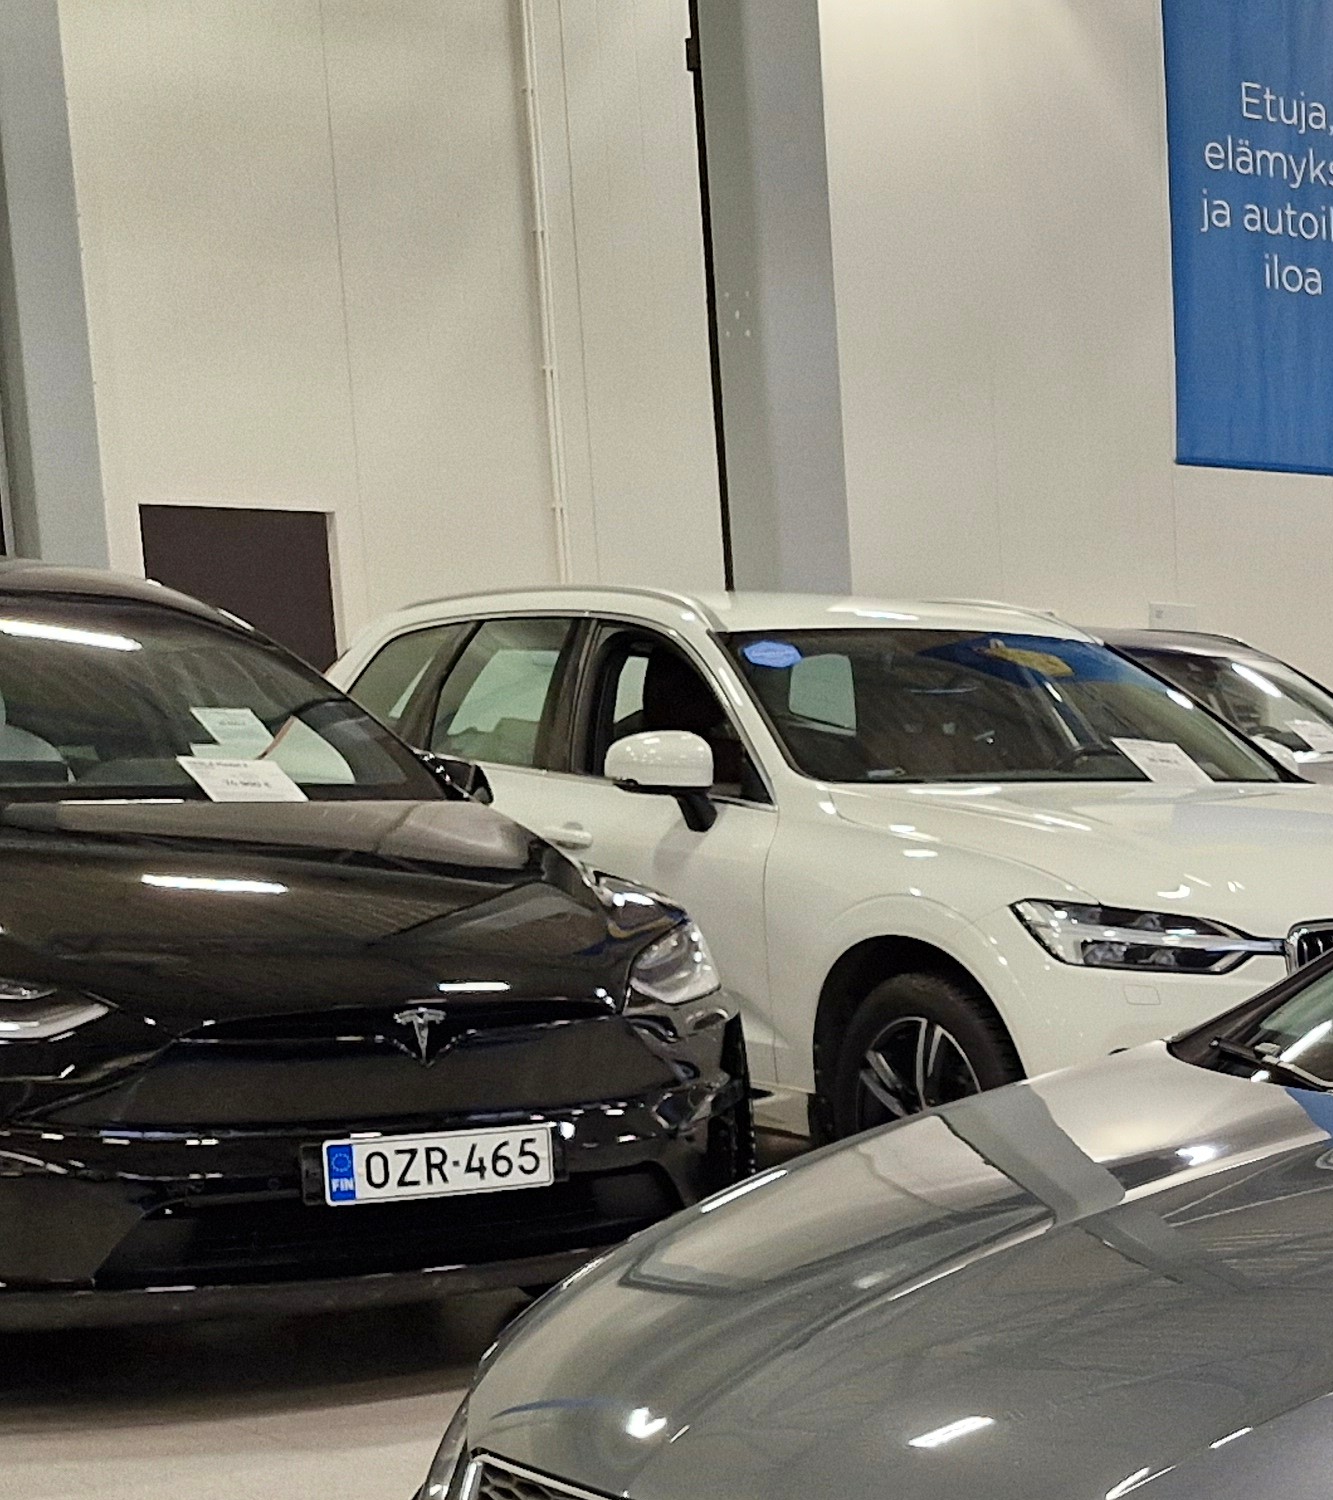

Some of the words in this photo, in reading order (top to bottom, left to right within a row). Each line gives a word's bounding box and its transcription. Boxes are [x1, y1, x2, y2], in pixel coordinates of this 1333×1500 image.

[1200, 188, 1231, 233] ja
[1263, 253, 1323, 296] iloa
[365, 1137, 541, 1190] OZR-465
